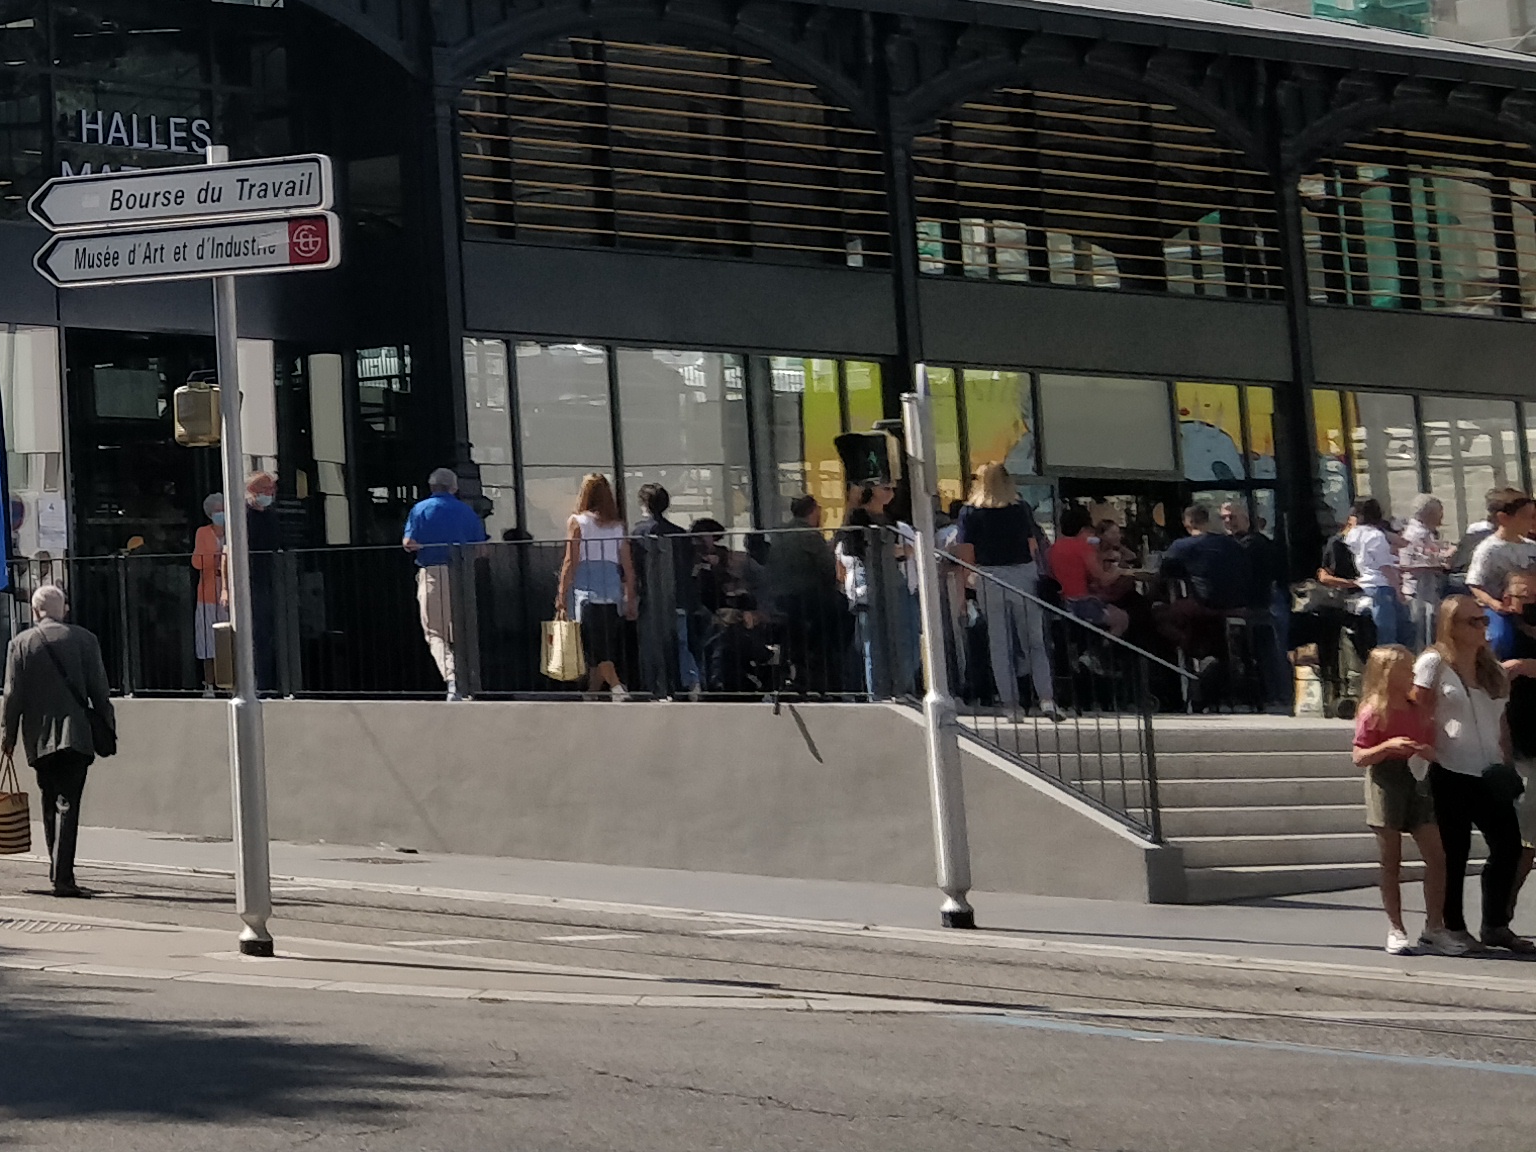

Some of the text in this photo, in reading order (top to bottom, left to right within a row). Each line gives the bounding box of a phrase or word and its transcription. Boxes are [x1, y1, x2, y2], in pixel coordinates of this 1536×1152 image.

[81, 109, 212, 154] HALLES
[109, 171, 314, 212] Bourse du Travail
[74, 245, 120, 270] Musée
[173, 241, 188, 263] et
